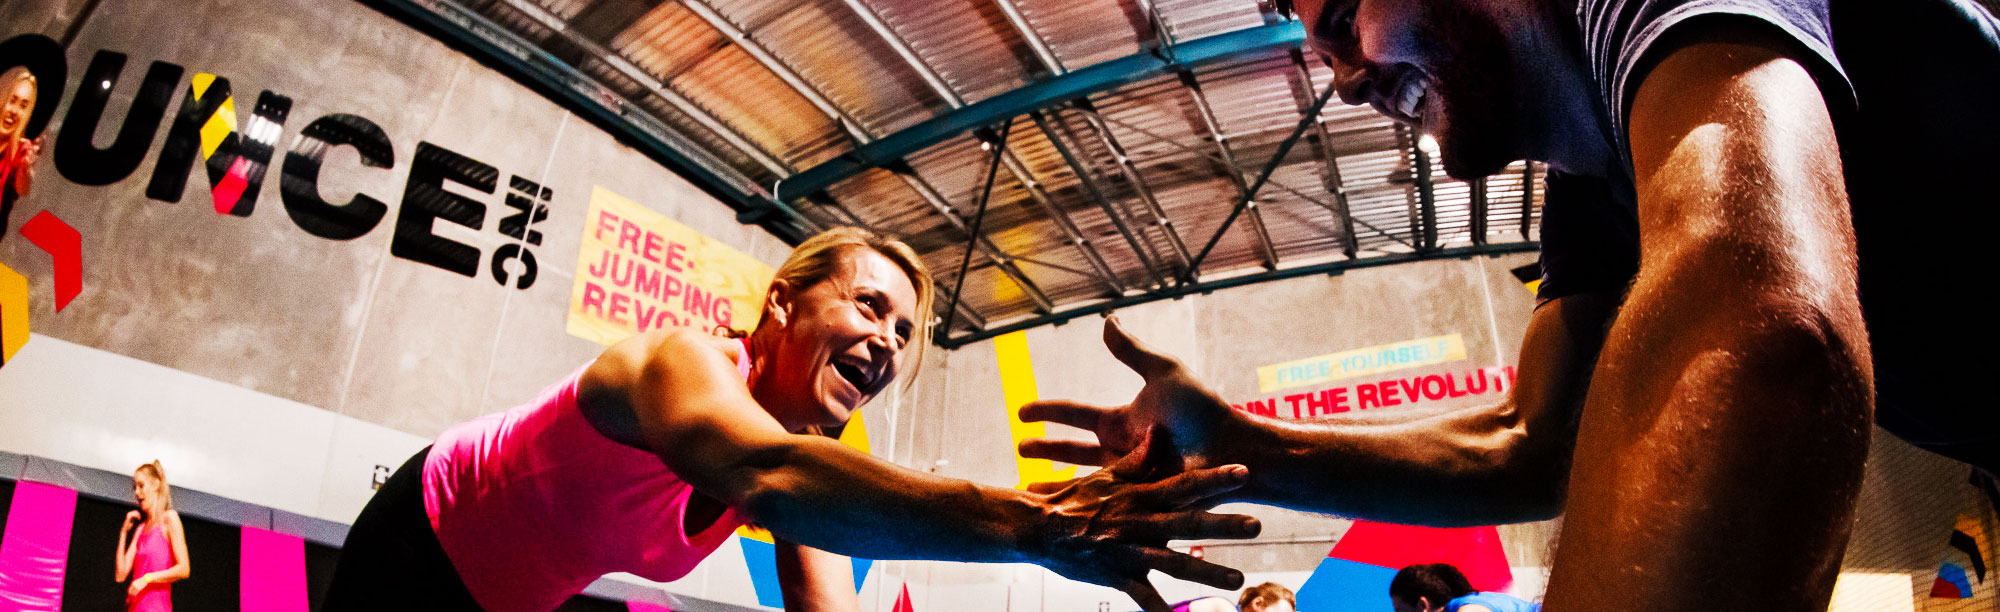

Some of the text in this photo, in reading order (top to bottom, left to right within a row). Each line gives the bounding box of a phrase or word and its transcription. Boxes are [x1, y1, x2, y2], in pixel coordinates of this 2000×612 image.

[491, 174, 553, 290] INC
[588, 249, 732, 327] JUMPING
[1277, 340, 1449, 385] FREE YOURSELF
[1284, 387, 1350, 419] THE
